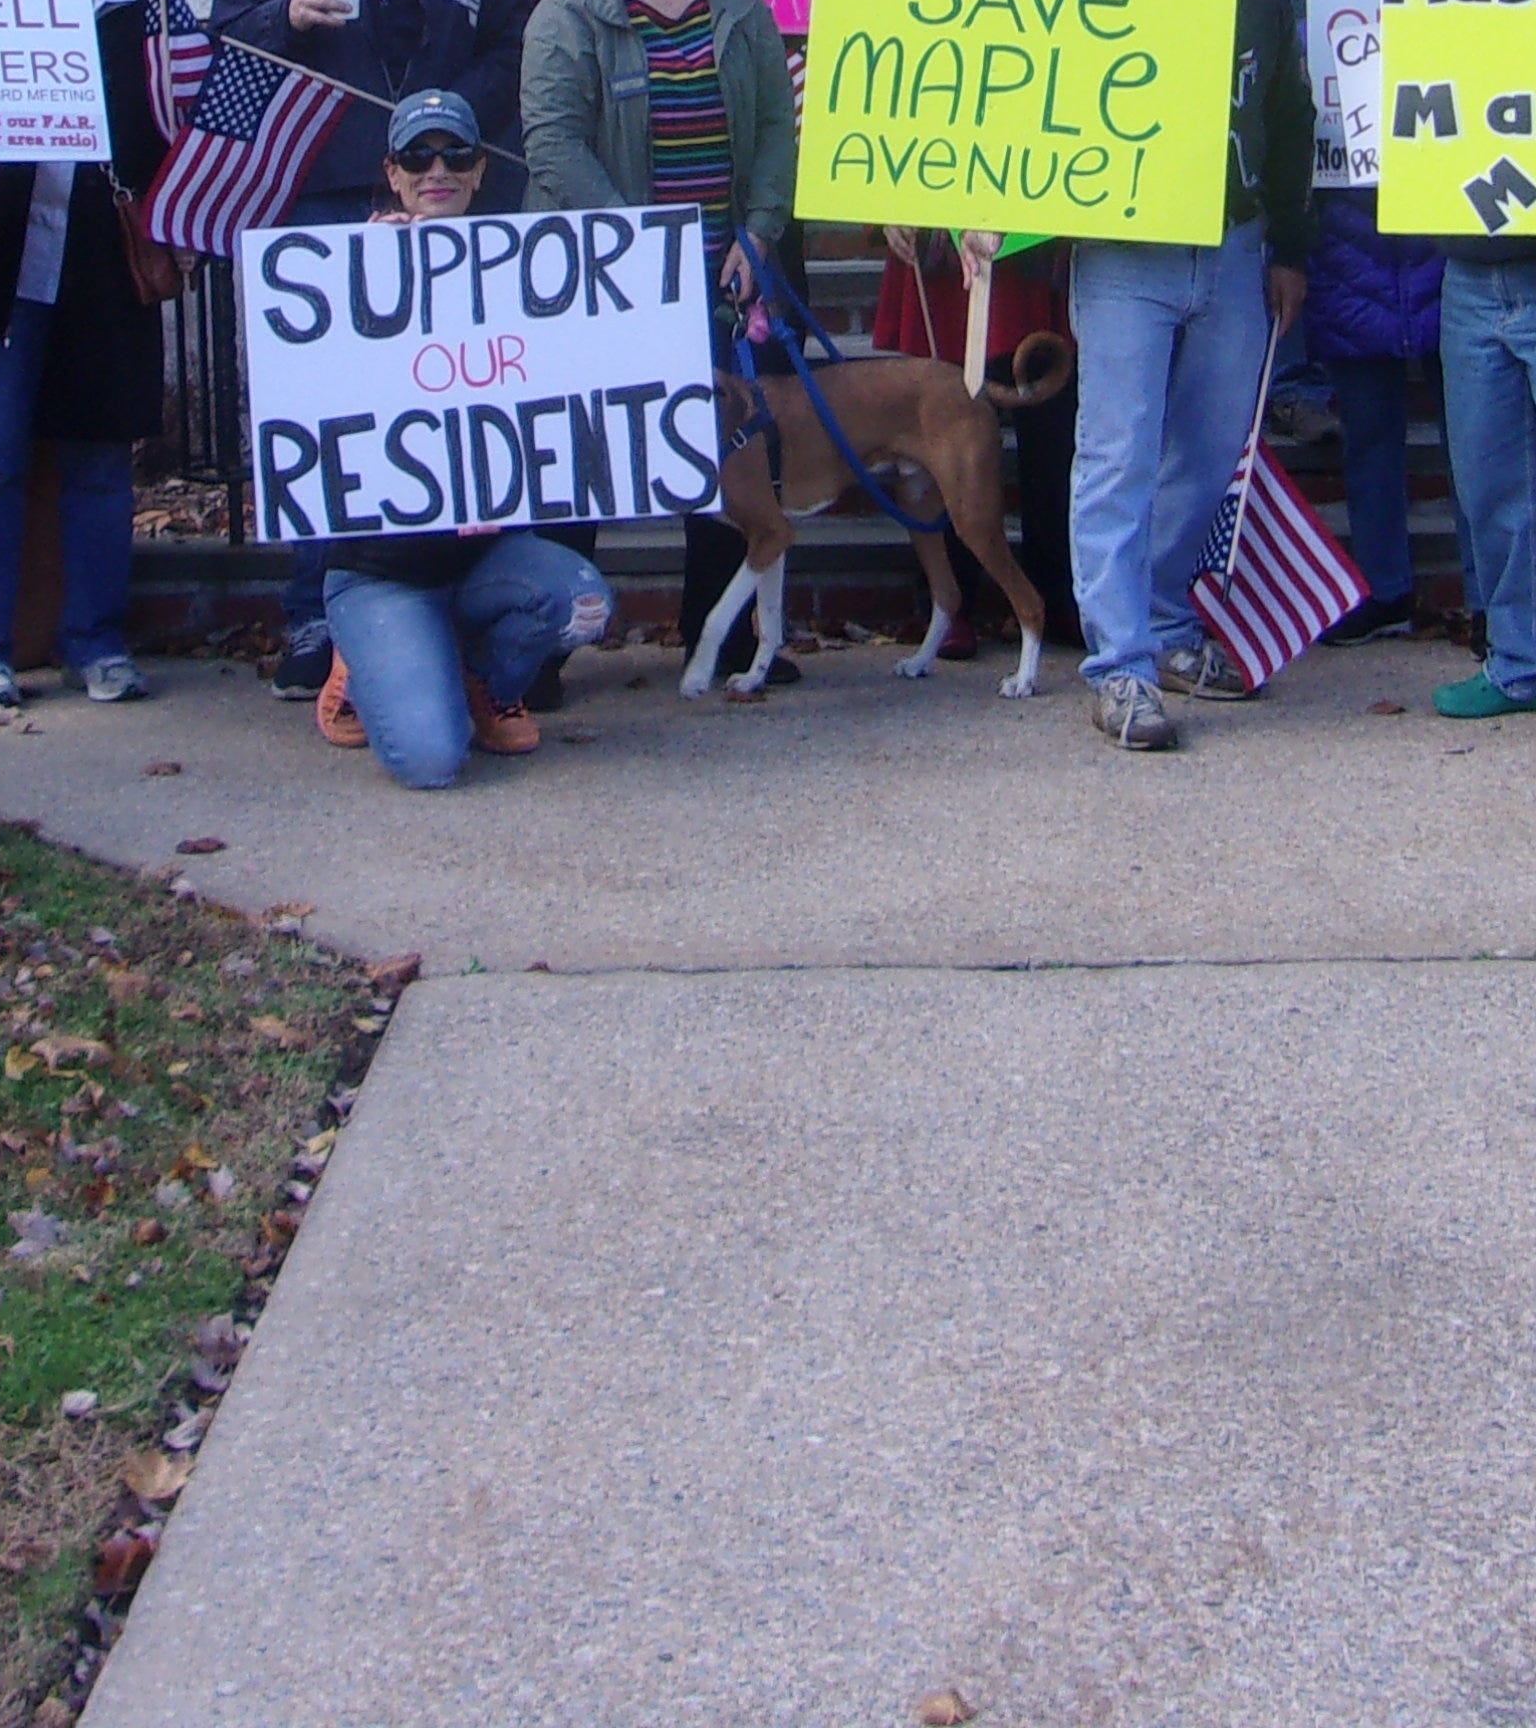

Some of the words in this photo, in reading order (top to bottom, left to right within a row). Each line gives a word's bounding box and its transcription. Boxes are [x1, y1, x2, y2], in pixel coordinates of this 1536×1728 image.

[27, 88, 96, 102] MEETING
[6, 117, 36, 128] our
[42, 115, 96, 130] F.A.R.
[8, 135, 44, 147] area
[50, 133, 98, 151] ratio)
[261, 207, 700, 344] SUPPORT
[413, 334, 527, 393] OUR
[259, 381, 720, 541] RESIDENTS
